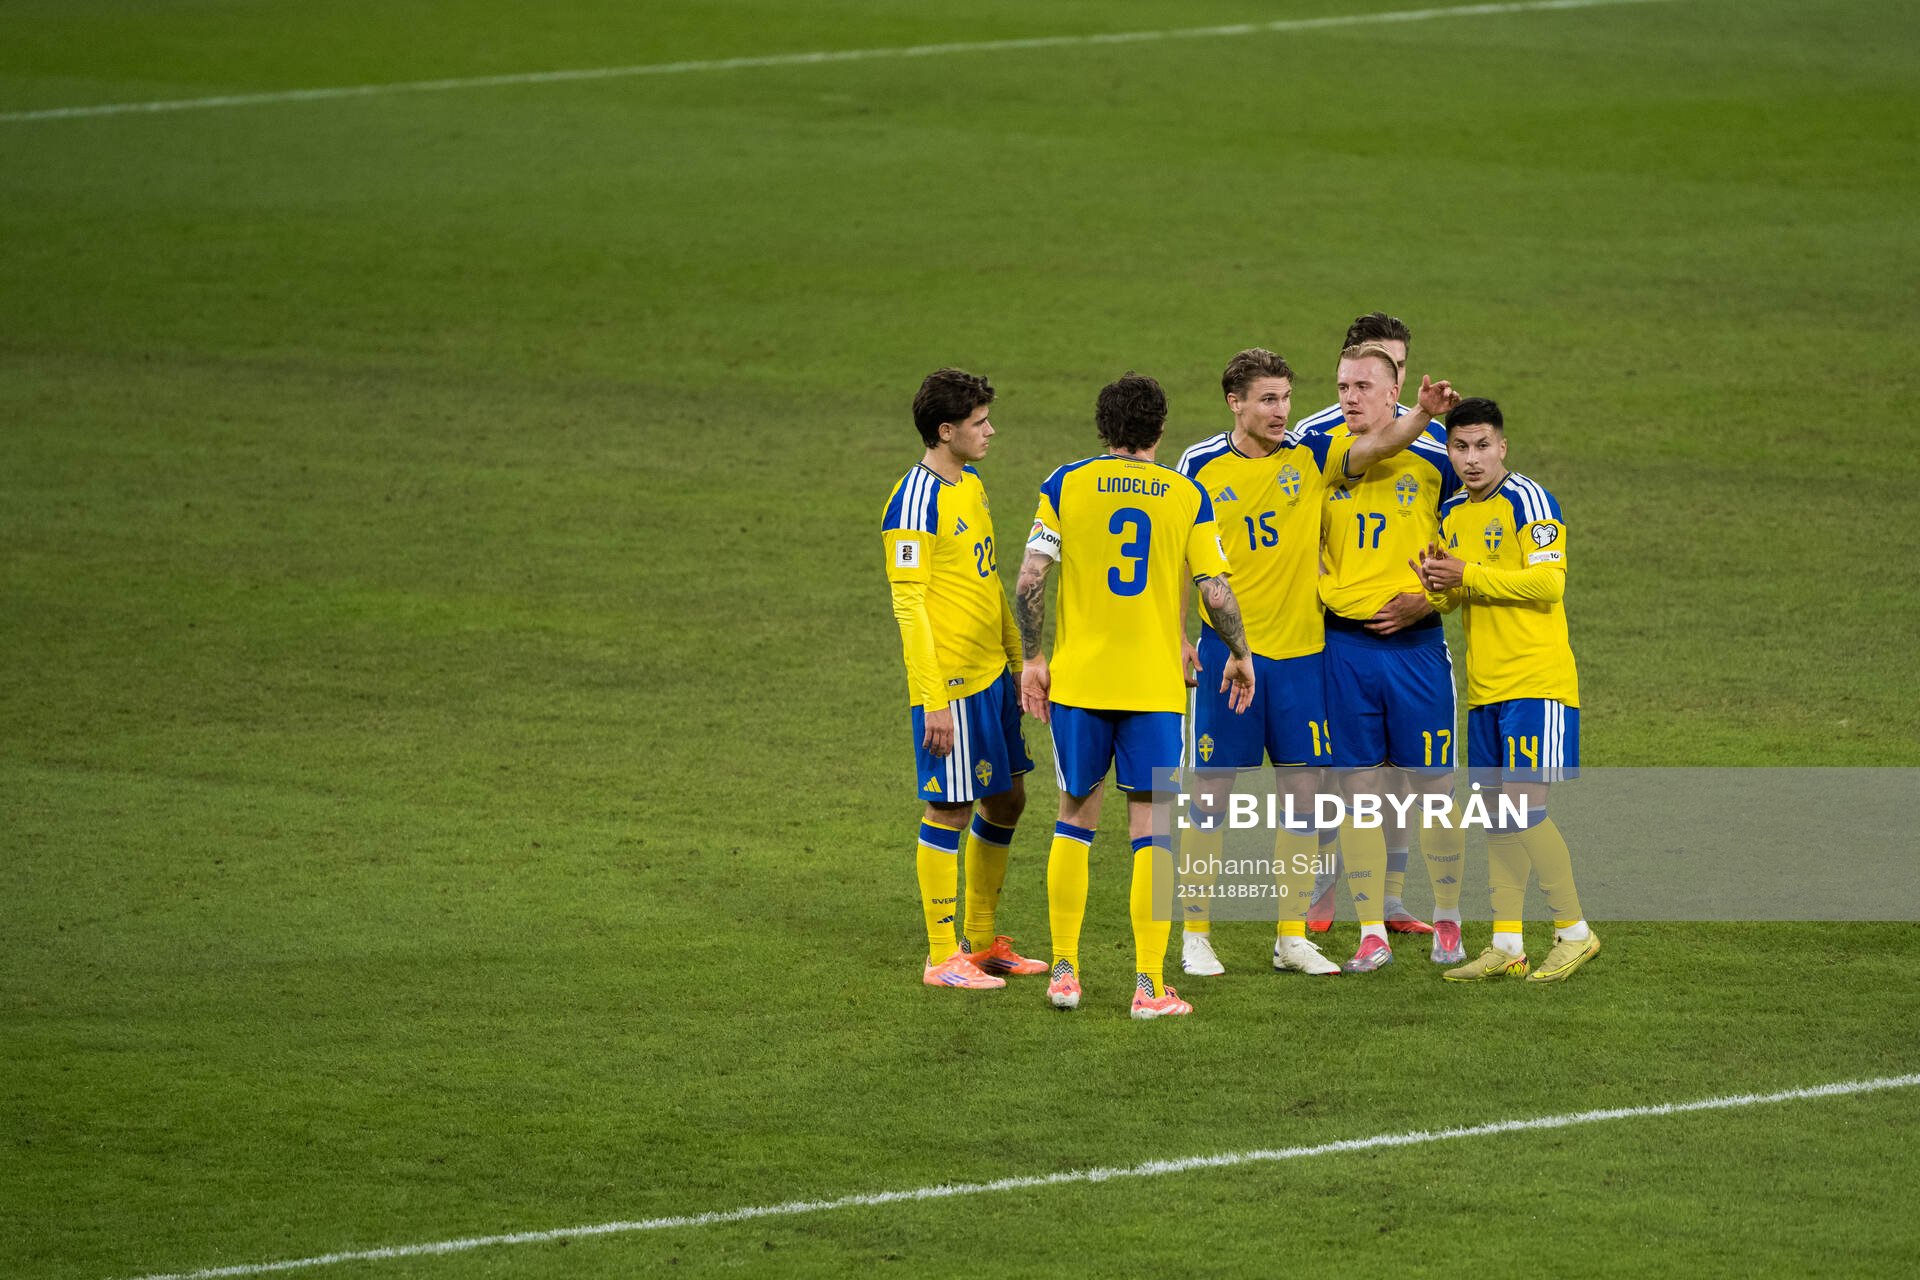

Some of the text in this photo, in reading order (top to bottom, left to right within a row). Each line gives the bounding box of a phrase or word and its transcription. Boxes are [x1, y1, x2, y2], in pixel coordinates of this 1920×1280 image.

[1097, 477, 1171, 498] LINDELÖF
[1244, 510, 1279, 551] 15
[1356, 512, 1387, 550] 17
[973, 536, 996, 578] 22
[1107, 507, 1152, 597] 3
[1422, 729, 1451, 766] 17
[1507, 735, 1538, 772] 14
